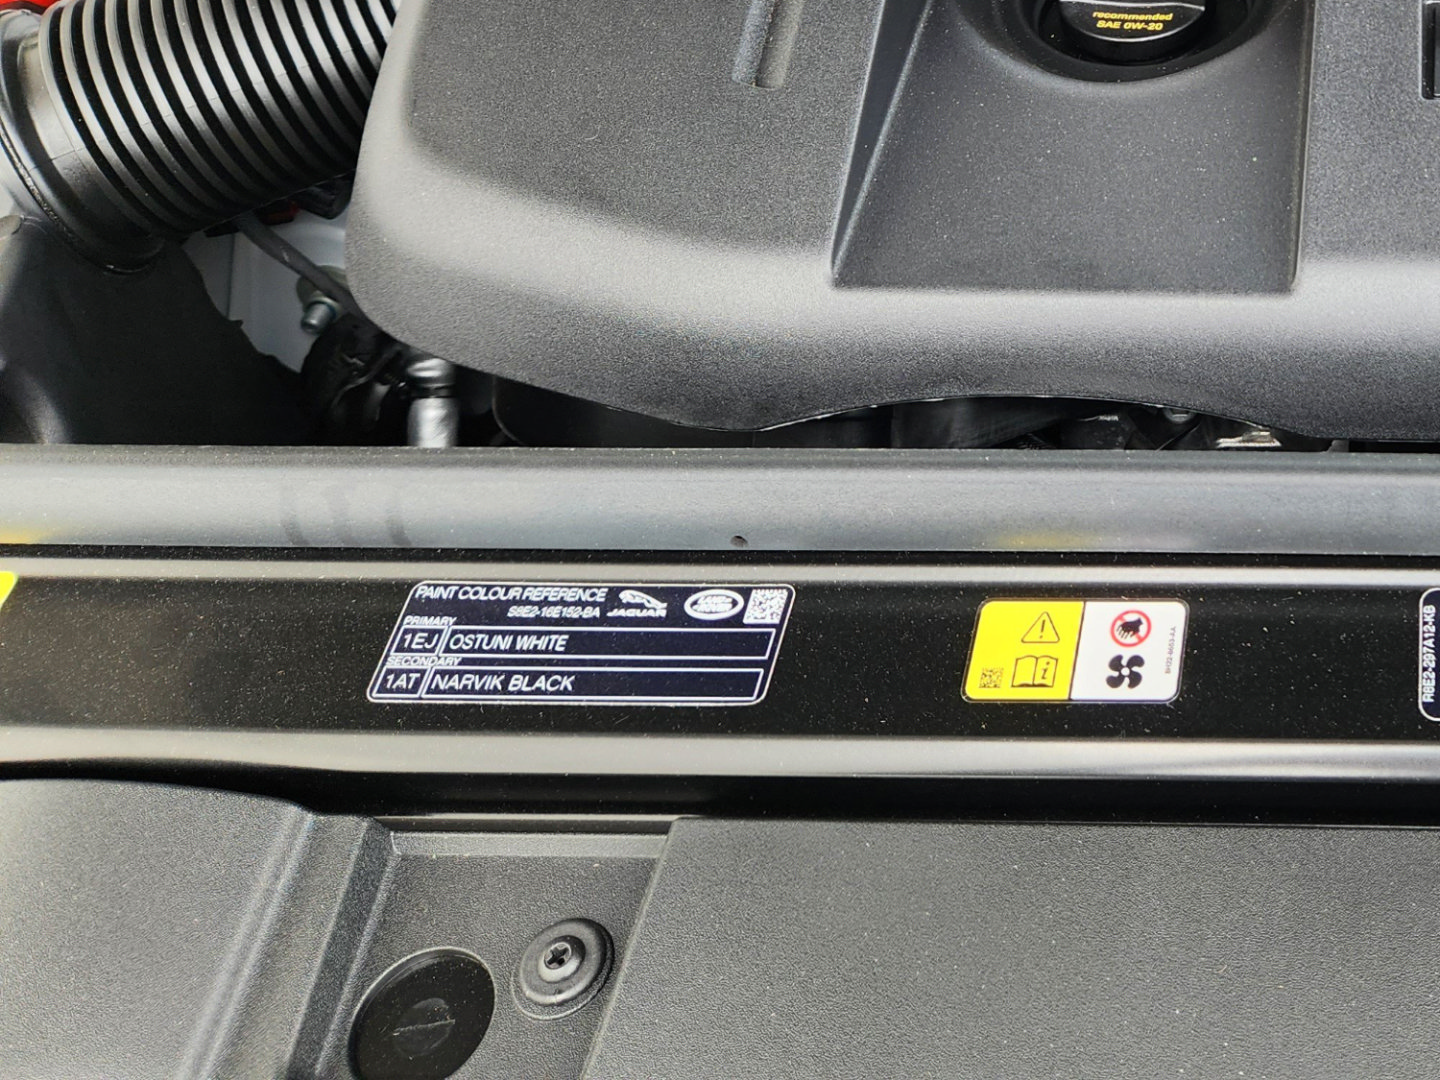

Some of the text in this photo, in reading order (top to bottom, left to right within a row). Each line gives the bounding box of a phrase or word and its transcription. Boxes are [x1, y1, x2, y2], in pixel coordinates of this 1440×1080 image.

[1092, 10, 1174, 21] recommended
[1096, 20, 1164, 31] SAE 0W-20
[415, 585, 607, 602] PAINT COLOUR REFERENCE
[606, 608, 668, 618] JAGUAR
[402, 615, 457, 626] PRIMARY
[402, 632, 570, 652] 1EJ OSTUNI WHITE
[385, 656, 463, 667] SECONDARY
[383, 673, 576, 692] 1AT NARVIK BLACK
